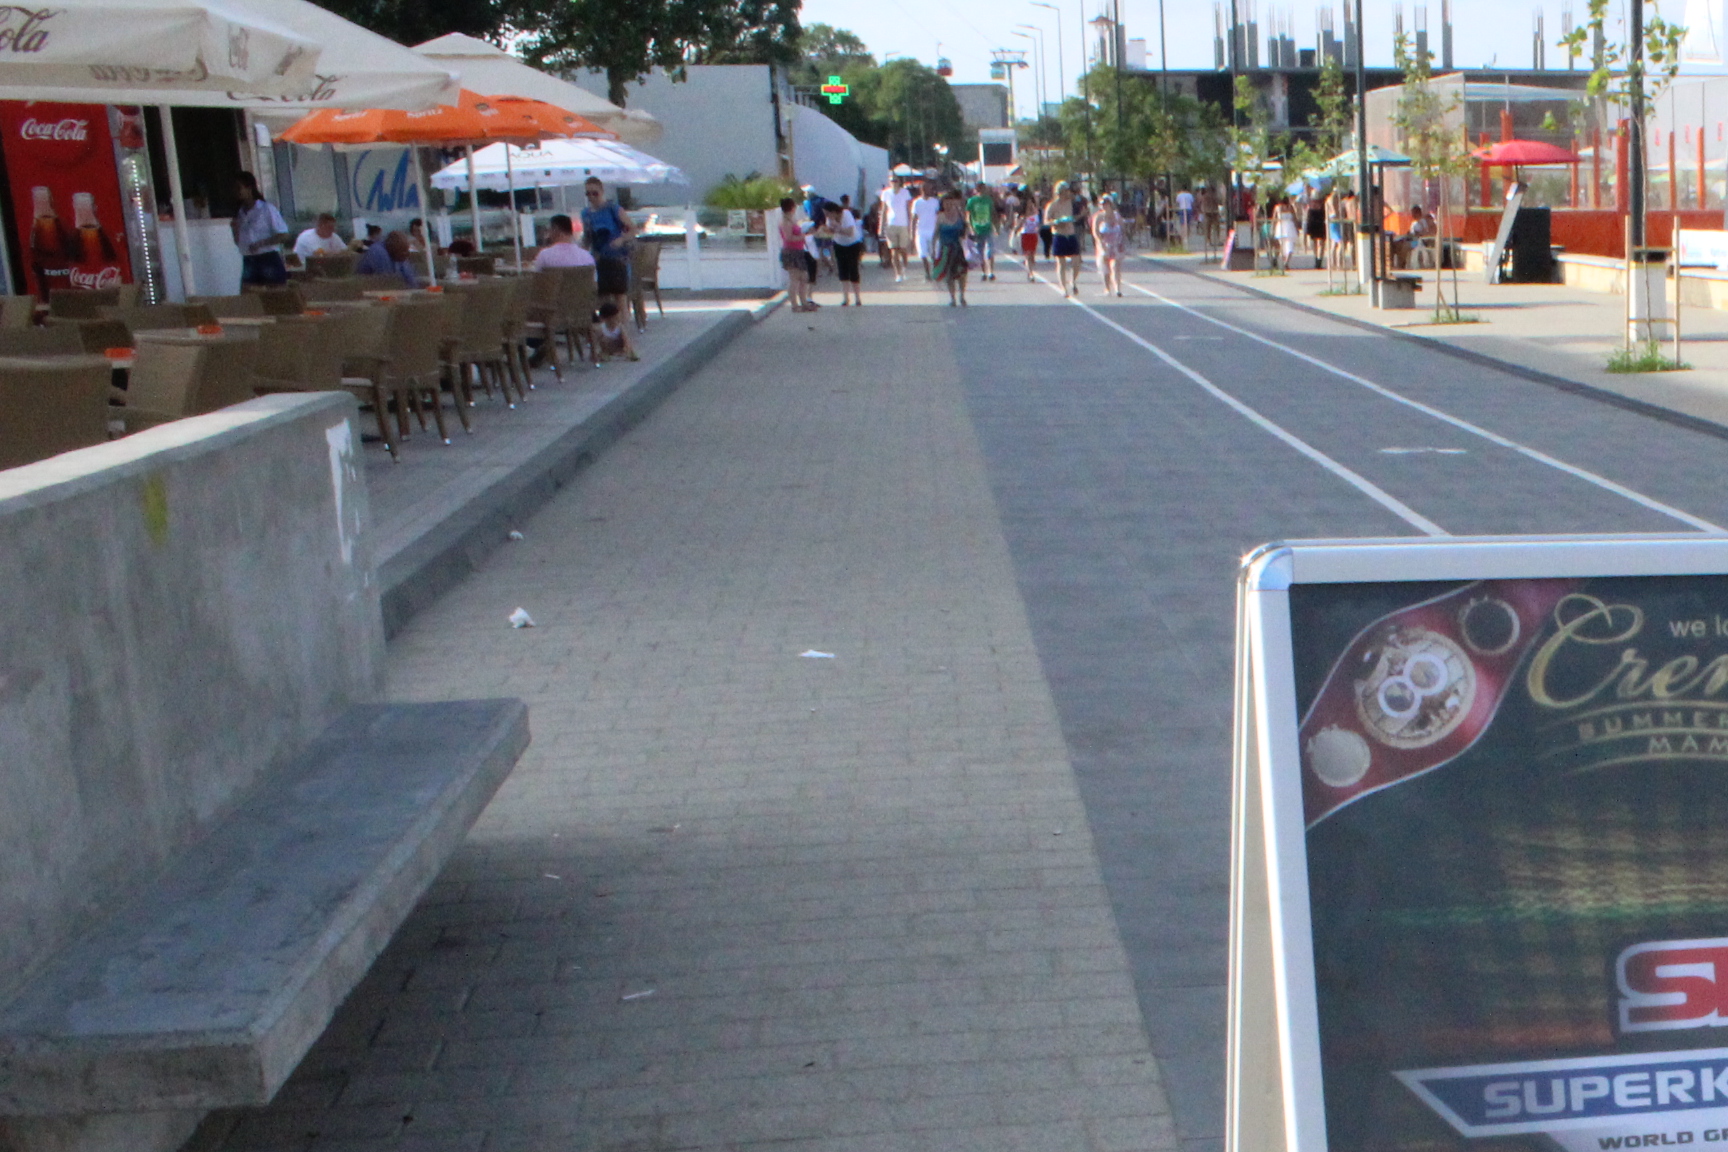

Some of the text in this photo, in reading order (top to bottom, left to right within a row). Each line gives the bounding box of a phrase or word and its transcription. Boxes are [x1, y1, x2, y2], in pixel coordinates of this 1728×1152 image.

[20, 118, 89, 141] Coca-Cola
[1669, 619, 1708, 638] we
[1598, 1128, 1693, 1151] WORLD
